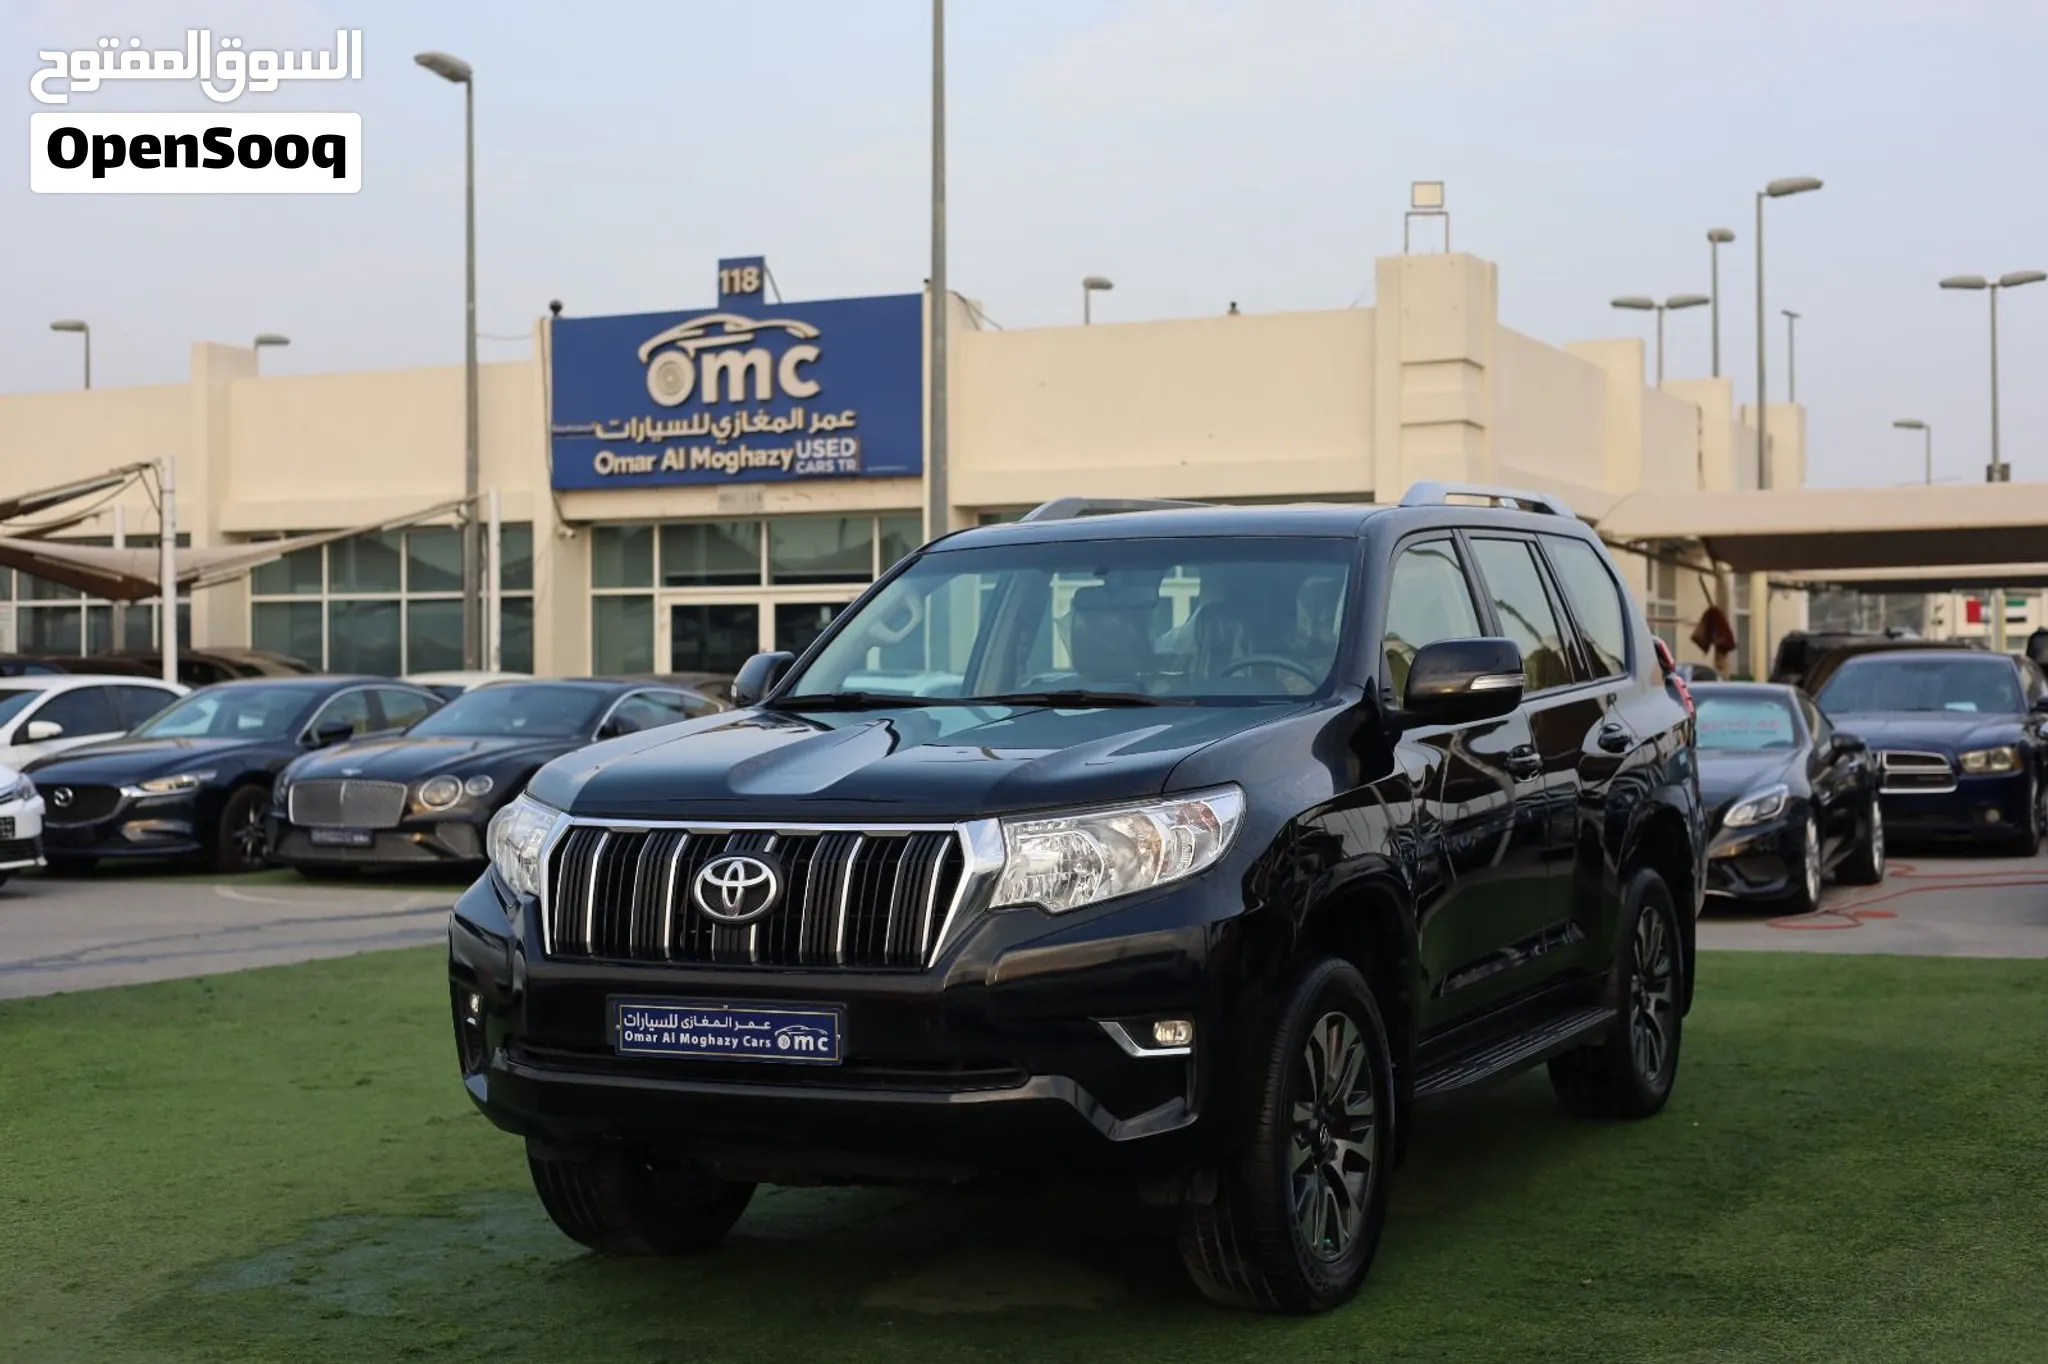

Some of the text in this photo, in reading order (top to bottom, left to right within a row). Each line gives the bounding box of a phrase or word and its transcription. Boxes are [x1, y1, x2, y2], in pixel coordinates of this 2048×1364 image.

[719, 265, 760, 294] 118
[594, 408, 857, 444] عمر المغازي للسيارات
[795, 437, 857, 459] USED
[593, 445, 796, 475] Omar Al Moghazy
[795, 459, 835, 474] CARS
[623, 1012, 679, 1032] للسيارات
[734, 1020, 772, 1031] عمر
[624, 1030, 772, 1049] Omar Al Moghazy Cars
